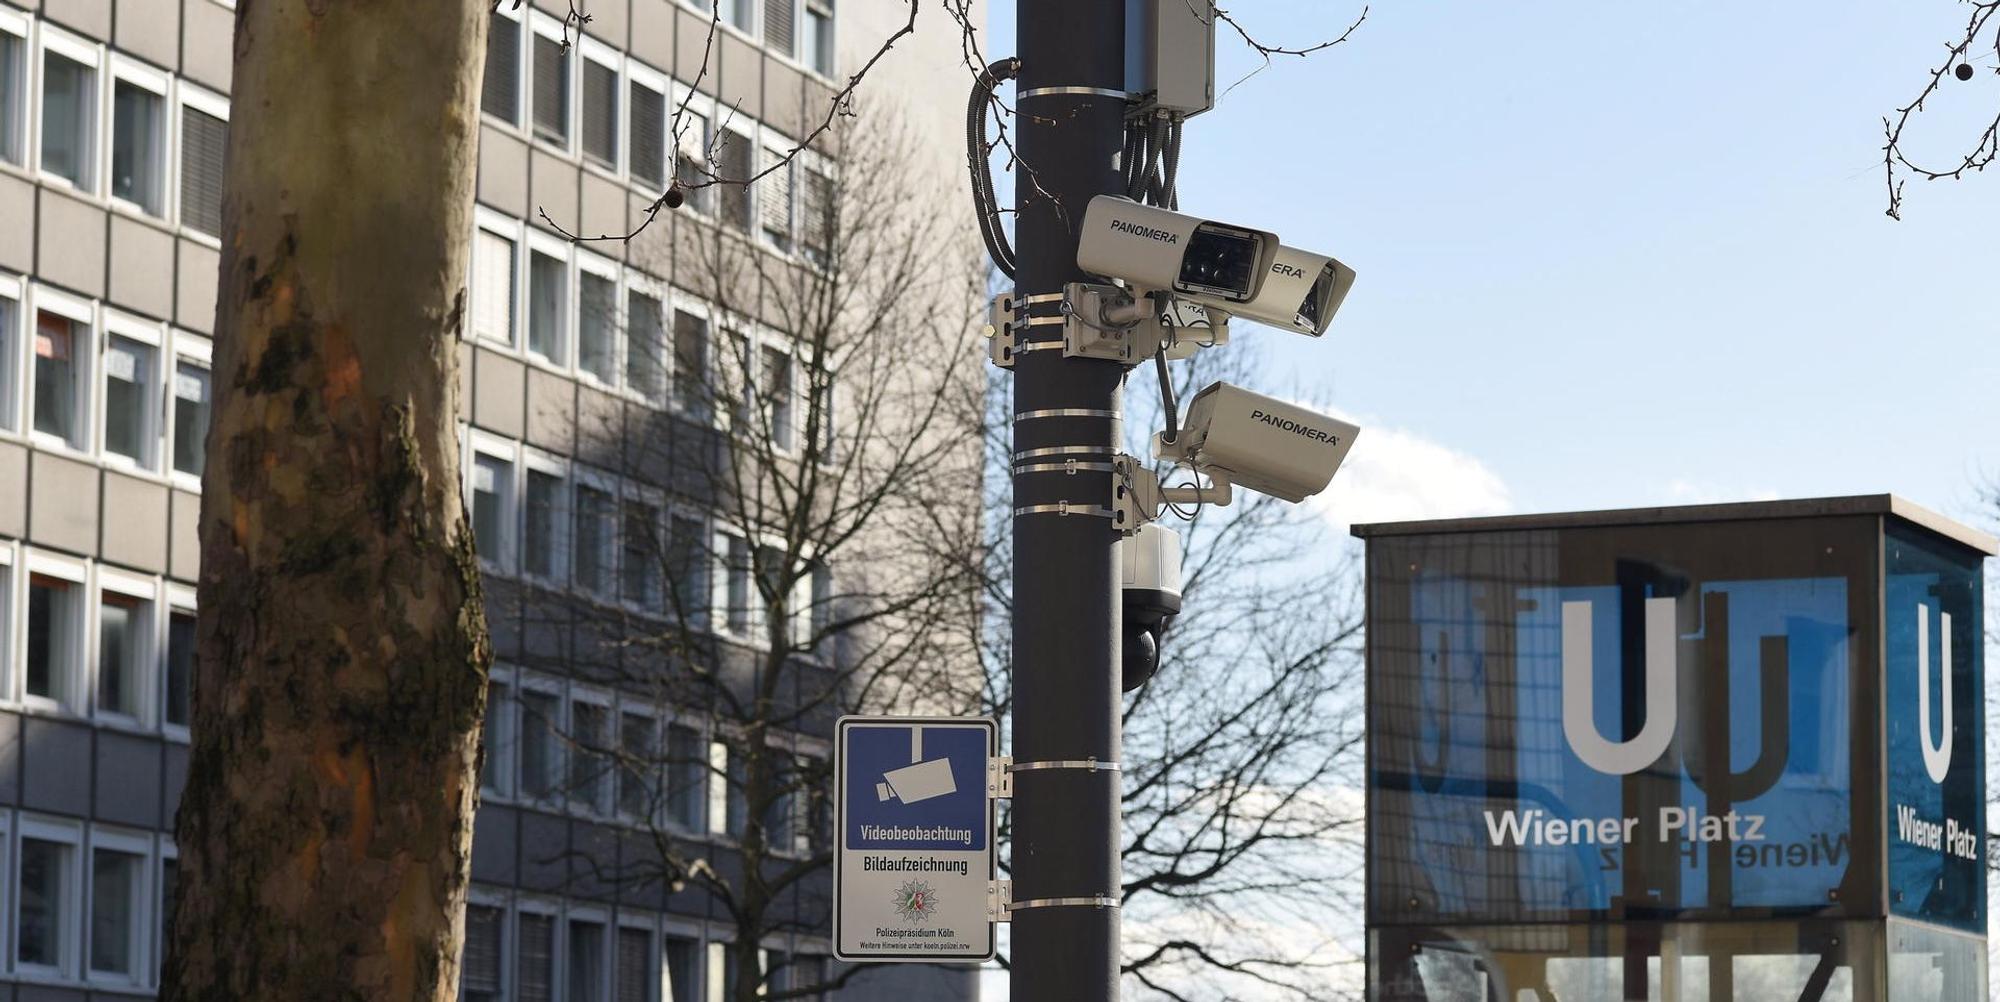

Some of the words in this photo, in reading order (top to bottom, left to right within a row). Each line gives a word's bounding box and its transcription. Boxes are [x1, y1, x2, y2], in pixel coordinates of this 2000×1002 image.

[1110, 219, 1177, 244] PANOMERA
[1251, 410, 1339, 446] PANOMERA
[1562, 597, 1677, 775] U
[1918, 603, 1953, 784] U
[860, 825, 972, 845] Videobeobachtung
[1484, 810, 1639, 847] Wiener
[1659, 806, 1766, 843] Platz
[1897, 804, 1943, 851] Wiener
[1946, 818, 1977, 860] Platz
[863, 856, 968, 876] Bildaufzeichnung
[876, 927, 936, 939] Polizeipräsidium
[937, 928, 955, 938] Köln
